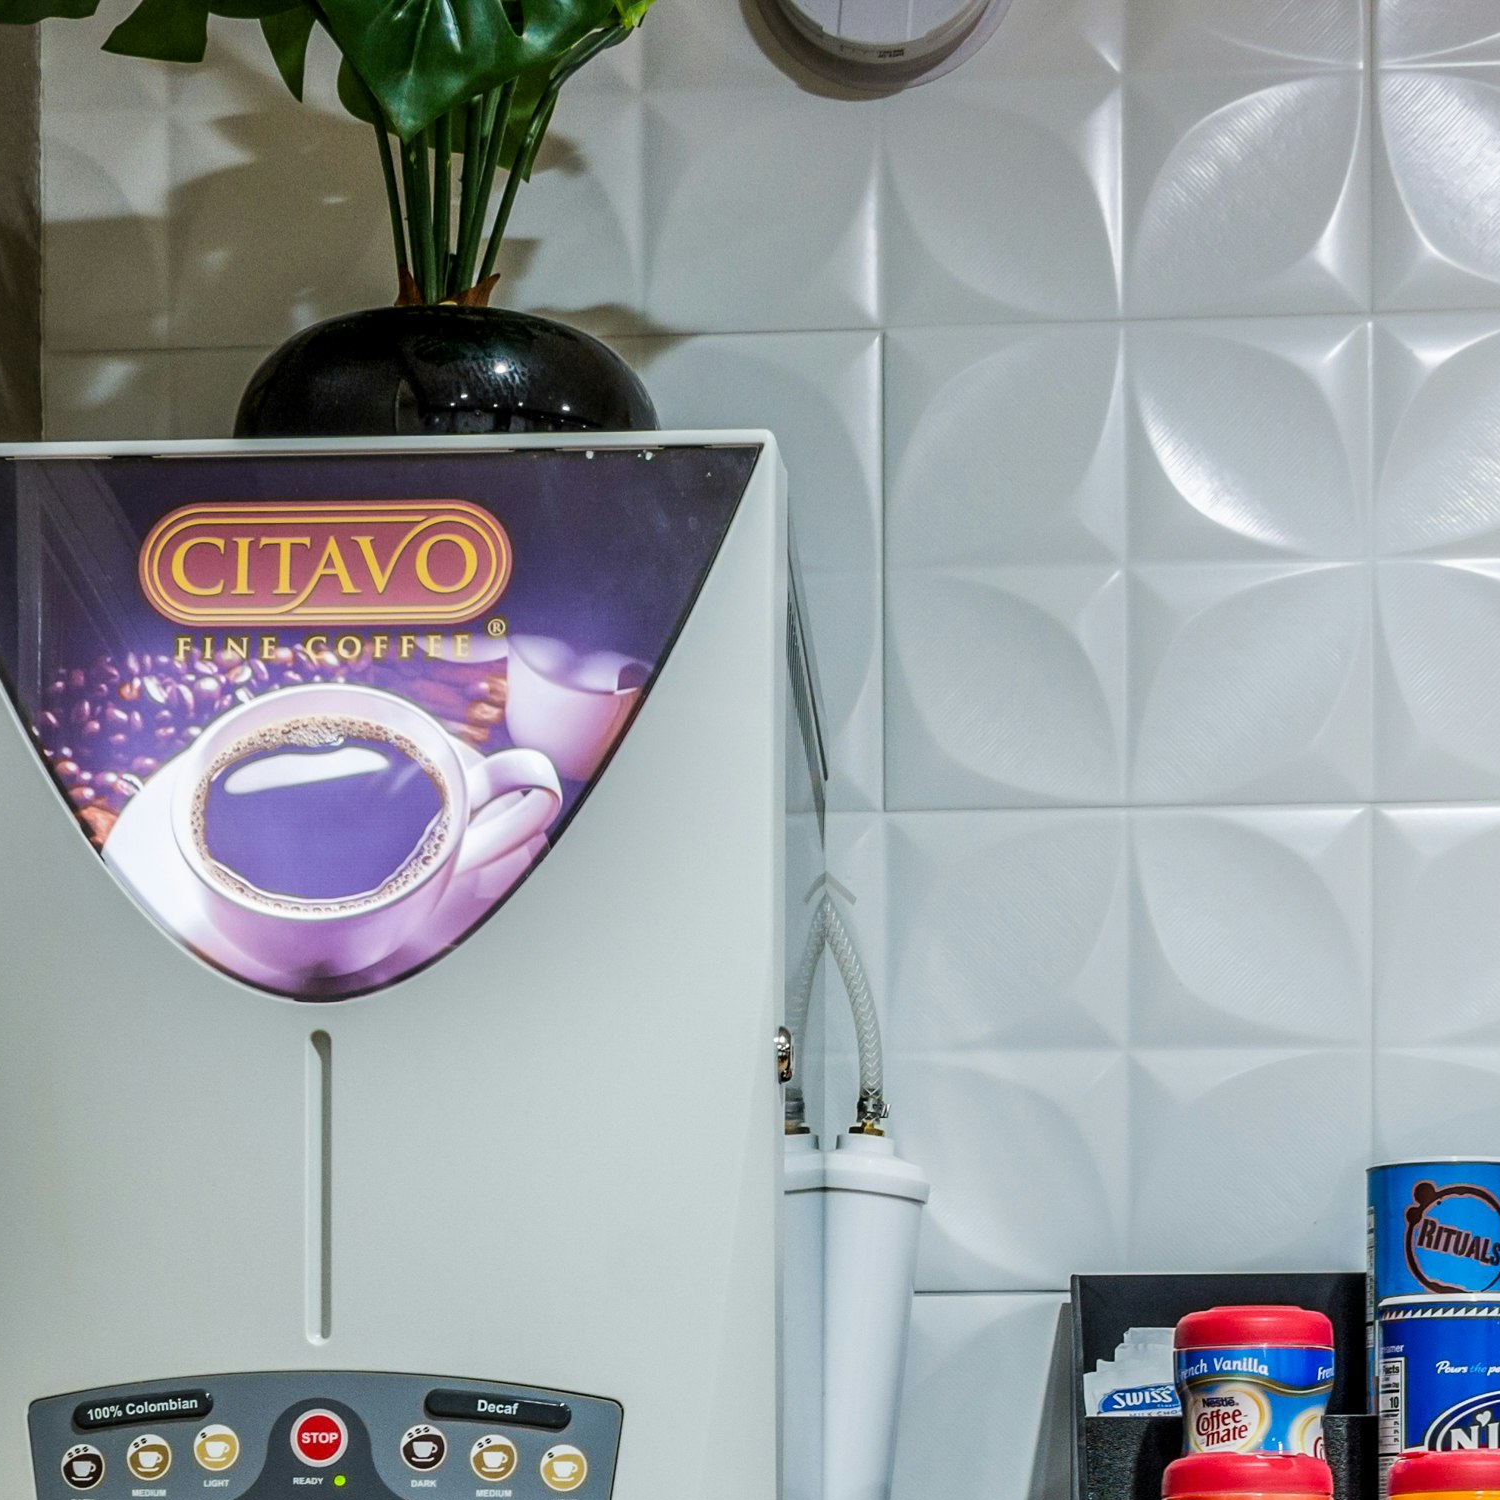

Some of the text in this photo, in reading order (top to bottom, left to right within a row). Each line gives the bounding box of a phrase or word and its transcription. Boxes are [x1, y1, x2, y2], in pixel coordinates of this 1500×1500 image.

[171, 533, 478, 596] CITAVO
[175, 634, 470, 661] FINE COFFEE
[1213, 1357, 1269, 1376] Vanilla
[1436, 1360, 1468, 1374] Pours
[1112, 1389, 1172, 1409] SWISS
[1389, 1396, 1399, 1409] 10
[87, 1398, 198, 1421] 100% Colombian
[477, 1399, 518, 1415] Decaf
[301, 1432, 338, 1444] STOP
[1206, 1423, 1248, 1446] mate
[203, 1479, 229, 1488] LIGHT
[293, 1477, 323, 1485] READY
[410, 1479, 437, 1488] DARK
[132, 1489, 167, 1497] MEDIUM
[476, 1489, 512, 1498] MEDIUM
